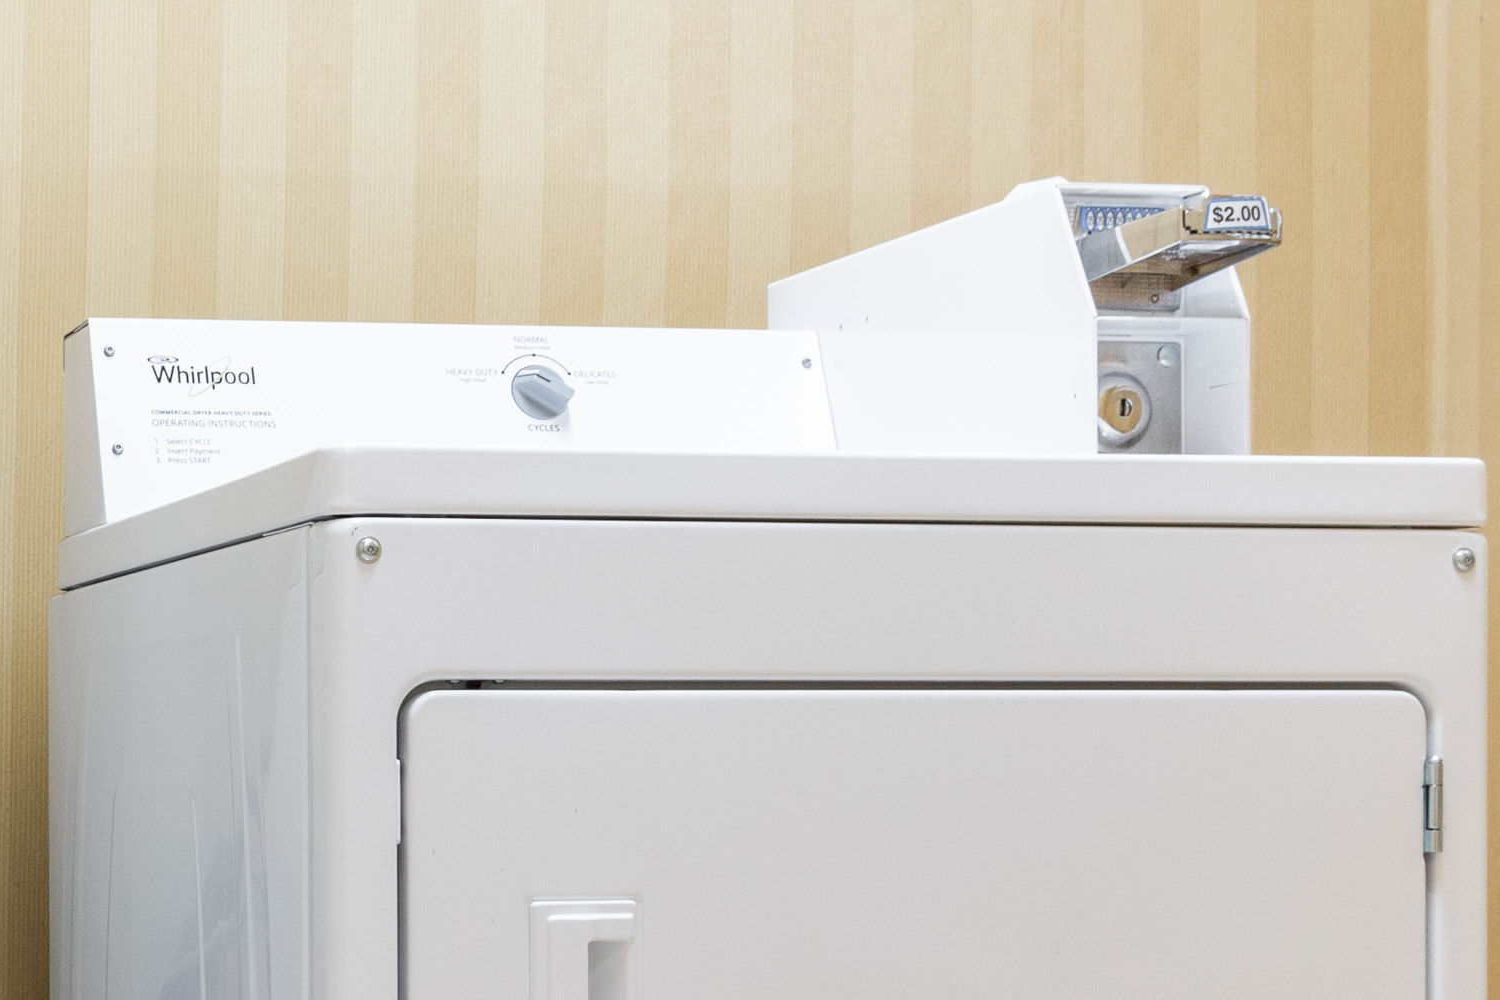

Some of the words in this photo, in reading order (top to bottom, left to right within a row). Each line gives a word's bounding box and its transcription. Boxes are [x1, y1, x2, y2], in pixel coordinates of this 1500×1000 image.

[1212, 205, 1261, 224] $2.00
[151, 365, 256, 390] Whirlpool
[151, 419, 206, 428] OPERATING
[208, 419, 277, 429] INSTRUCTIONS
[528, 424, 560, 432] CYCLES
